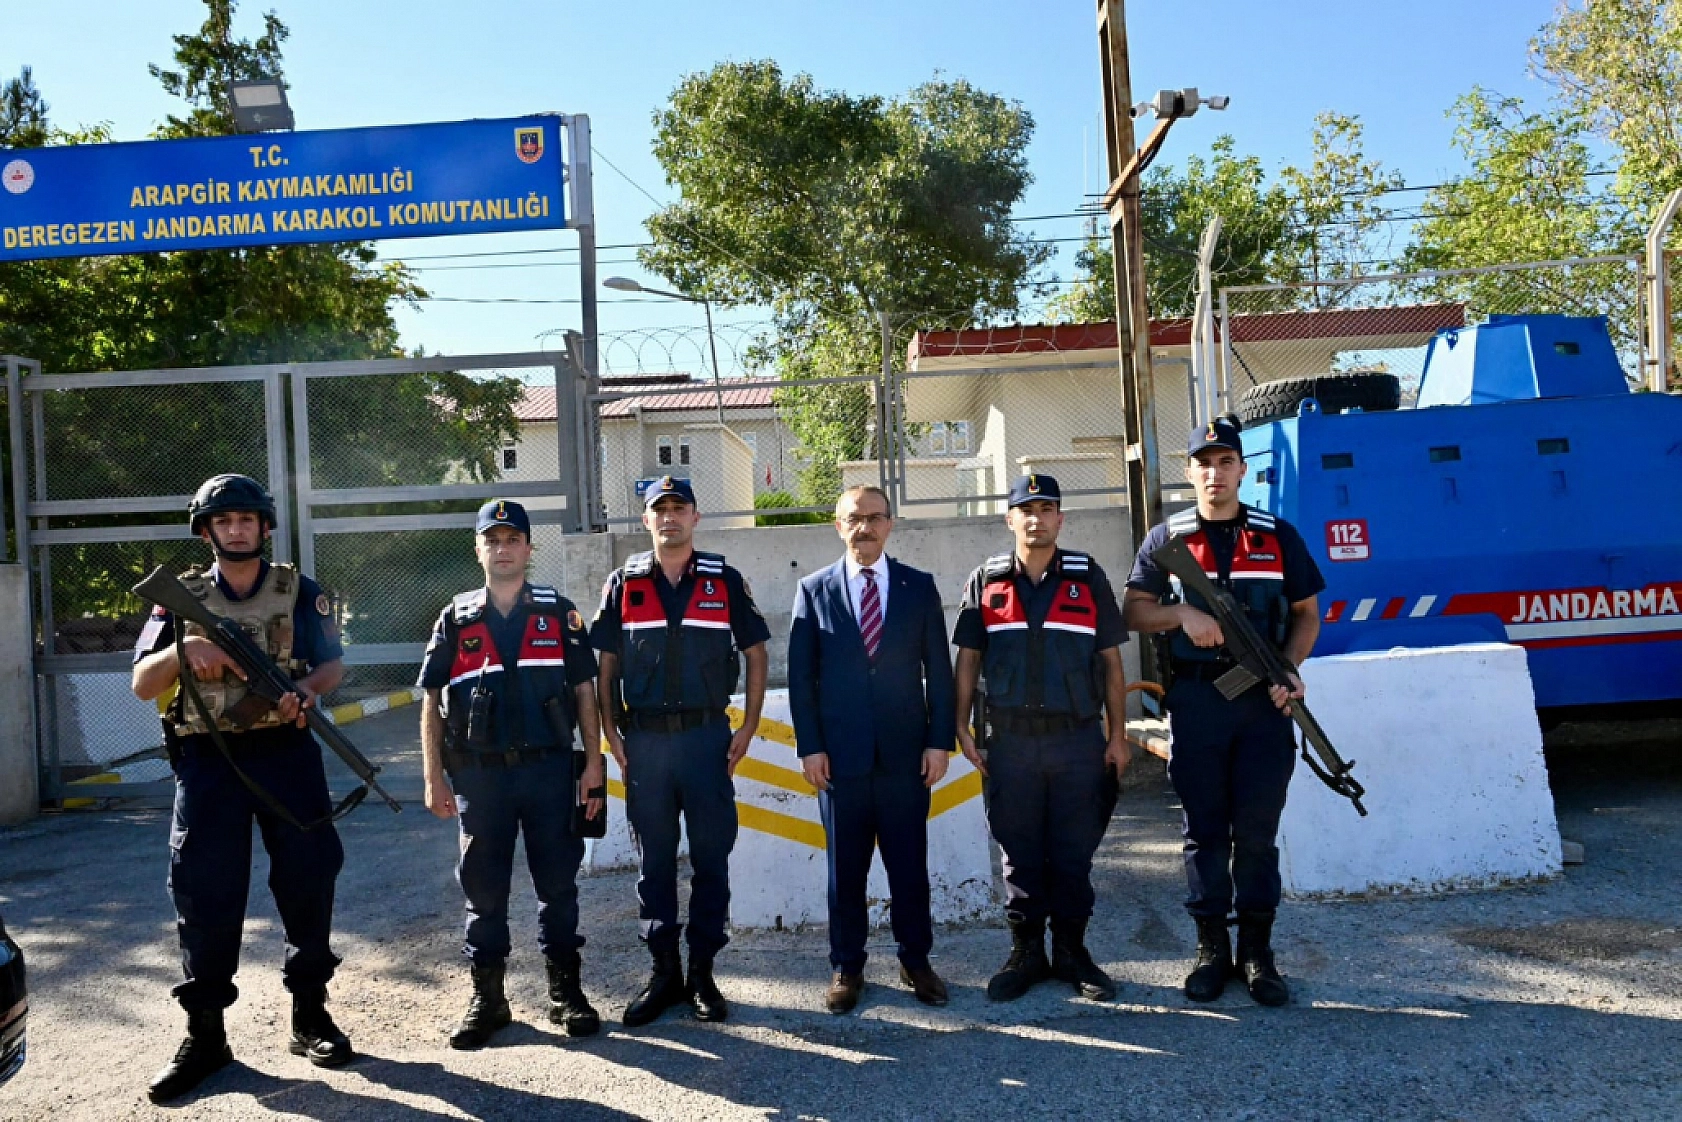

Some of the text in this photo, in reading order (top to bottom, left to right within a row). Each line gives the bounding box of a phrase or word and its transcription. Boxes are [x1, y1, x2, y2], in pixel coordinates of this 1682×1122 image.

[249, 144, 289, 168] T.C.
[130, 167, 413, 208] ARAPGİR KAYMAKAMLIĞI
[3, 192, 549, 249] DEREGEZEN JANDARMA KARAKOL KOMUTANLIĞI
[1331, 523, 1363, 543] 112
[1511, 587, 1680, 622] JANDARMA
